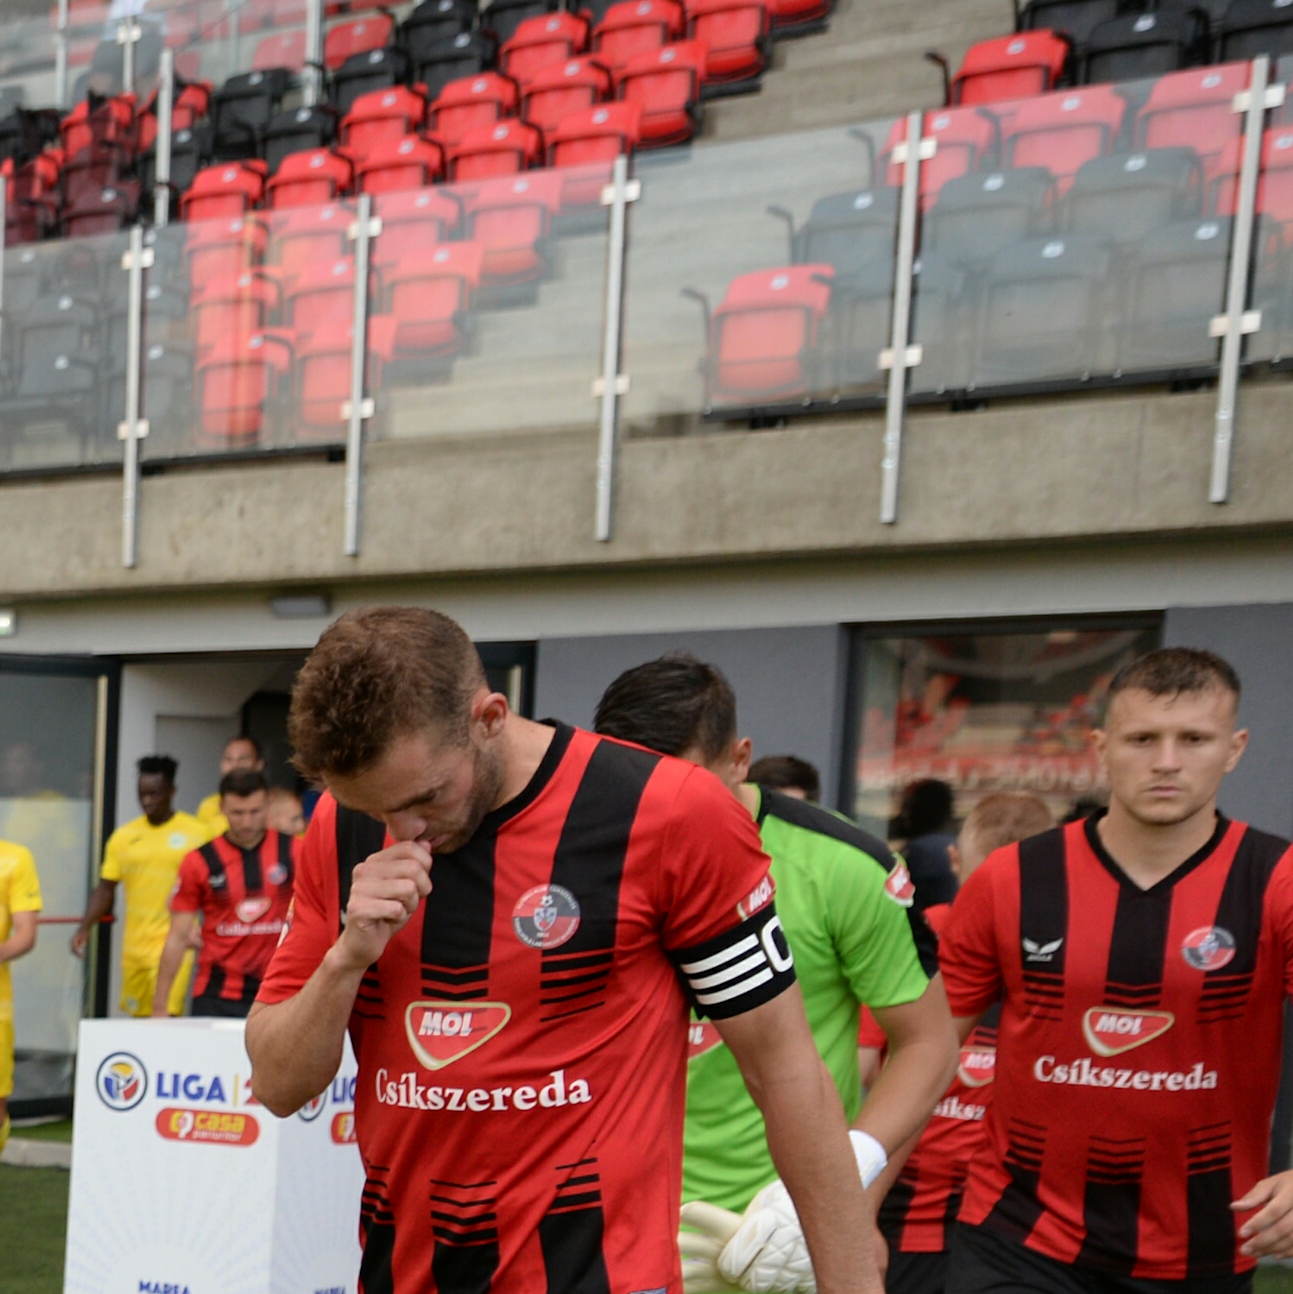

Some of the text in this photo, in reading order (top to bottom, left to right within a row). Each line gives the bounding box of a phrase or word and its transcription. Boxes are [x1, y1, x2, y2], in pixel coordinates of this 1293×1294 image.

[419, 1011, 473, 1037] MOL
[1095, 1013, 1143, 1035] MOL
[1033, 1055, 1218, 1091] Csíkszereda
[156, 1072, 227, 1104] LIGA
[375, 1067, 592, 1112] Csíkszereda
[194, 1112, 246, 1133] casa
